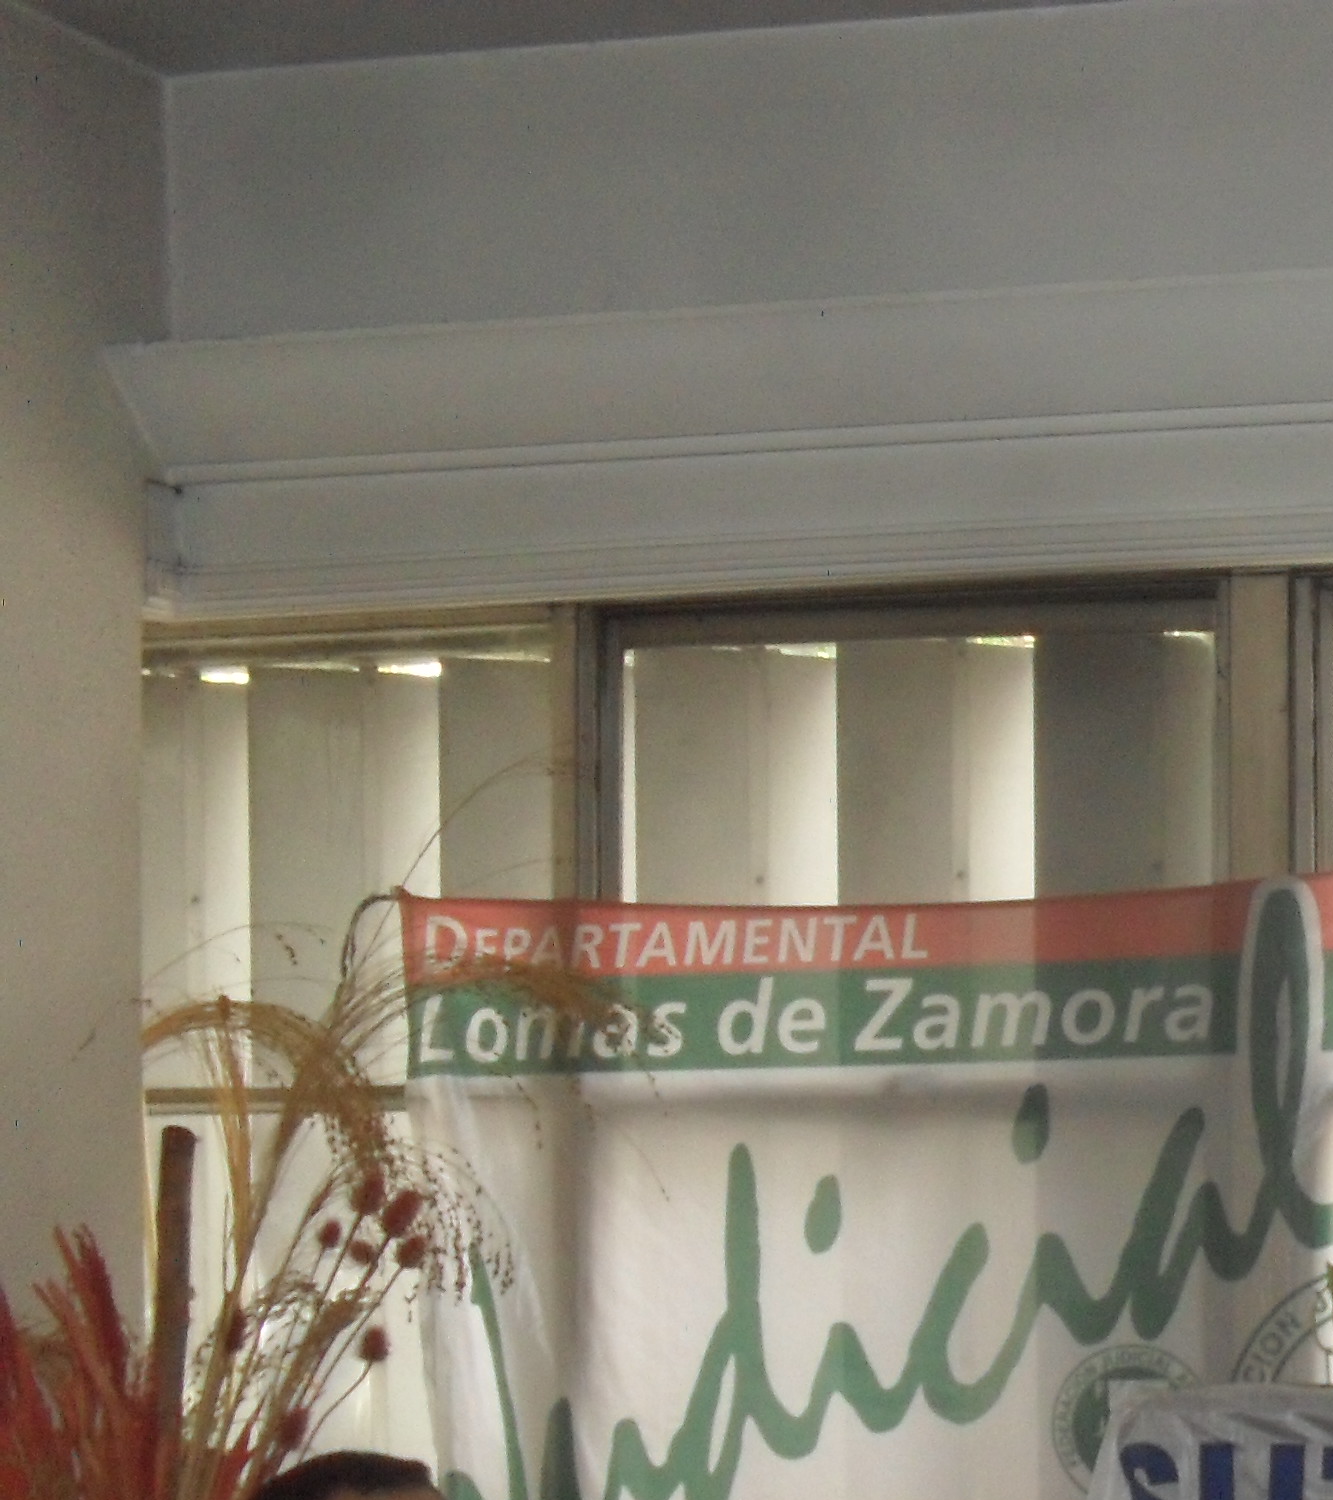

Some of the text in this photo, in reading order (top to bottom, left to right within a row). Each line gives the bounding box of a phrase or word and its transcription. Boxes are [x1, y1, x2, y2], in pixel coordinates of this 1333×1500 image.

[418, 974, 1214, 1064] Lomas de Zamora
